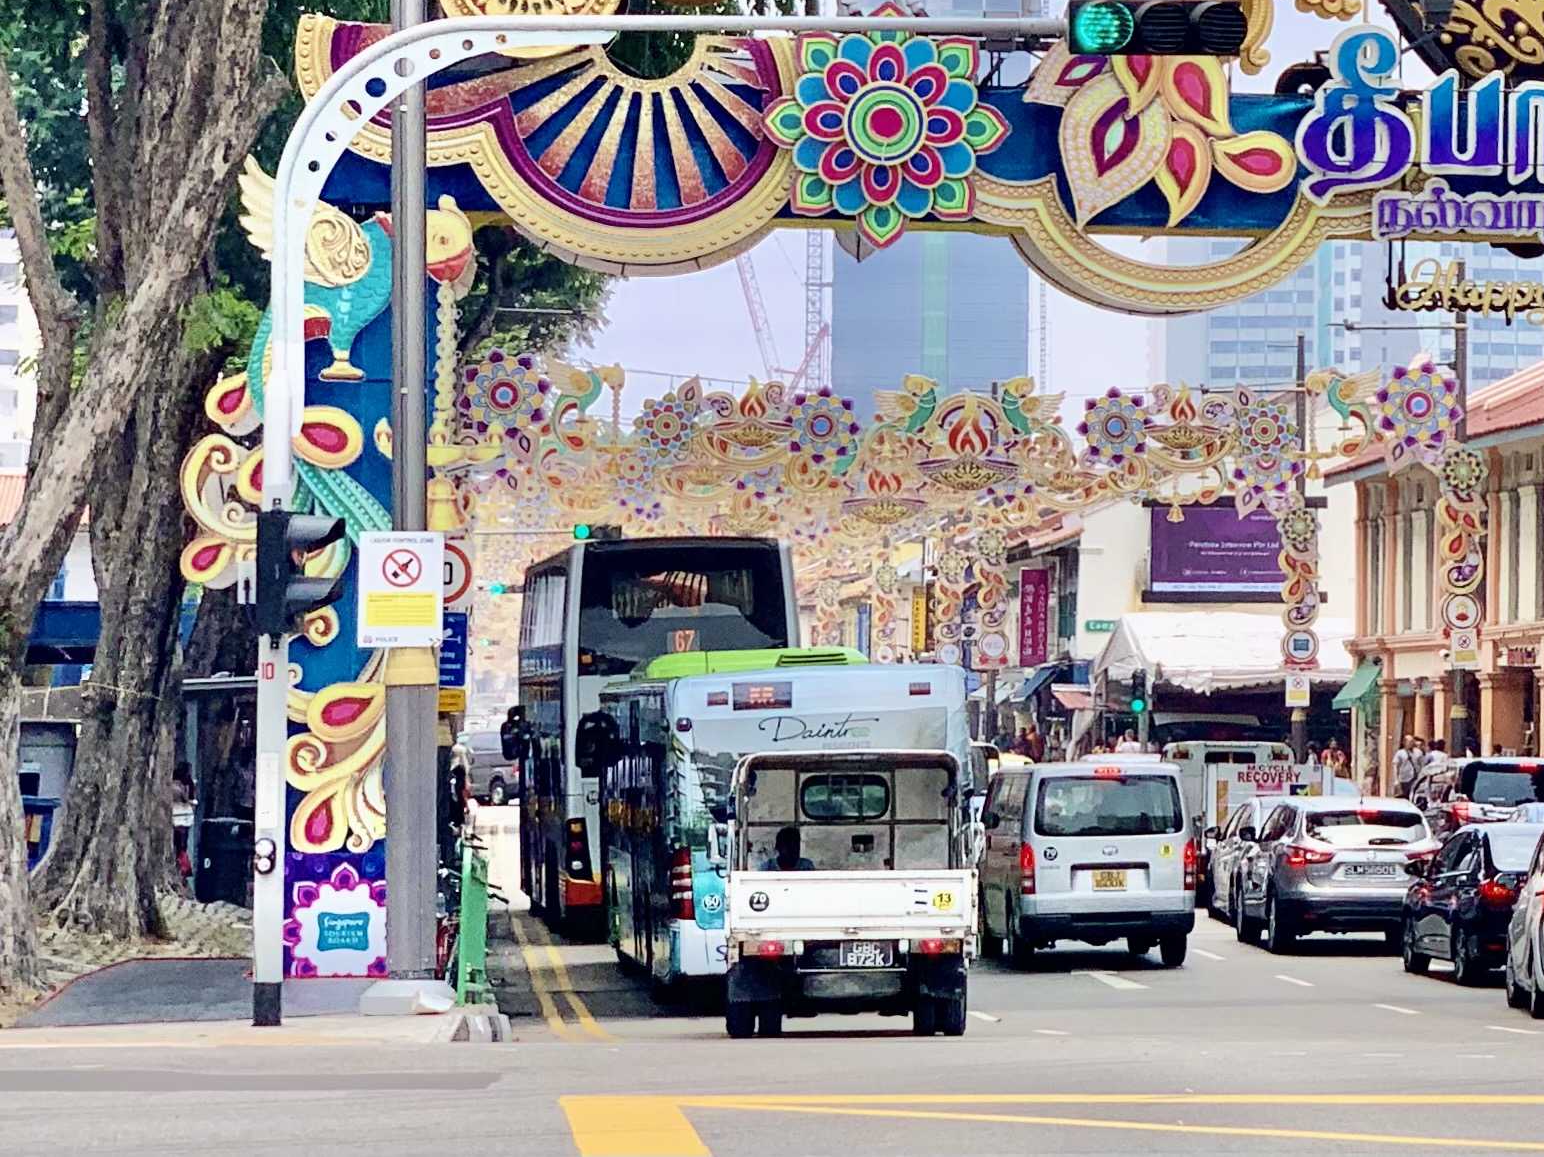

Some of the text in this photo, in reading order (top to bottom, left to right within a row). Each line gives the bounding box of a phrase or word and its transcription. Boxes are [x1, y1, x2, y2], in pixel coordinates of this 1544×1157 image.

[673, 629, 695, 652] 67
[261, 662, 275, 680] 10
[757, 712, 880, 742] Daintree
[1237, 771, 1301, 783] RECOVERY
[705, 896, 720, 906] 60
[753, 893, 767, 904] 70
[937, 893, 951, 903] 13
[852, 942, 881, 954] GBC
[847, 953, 886, 967] 872K
